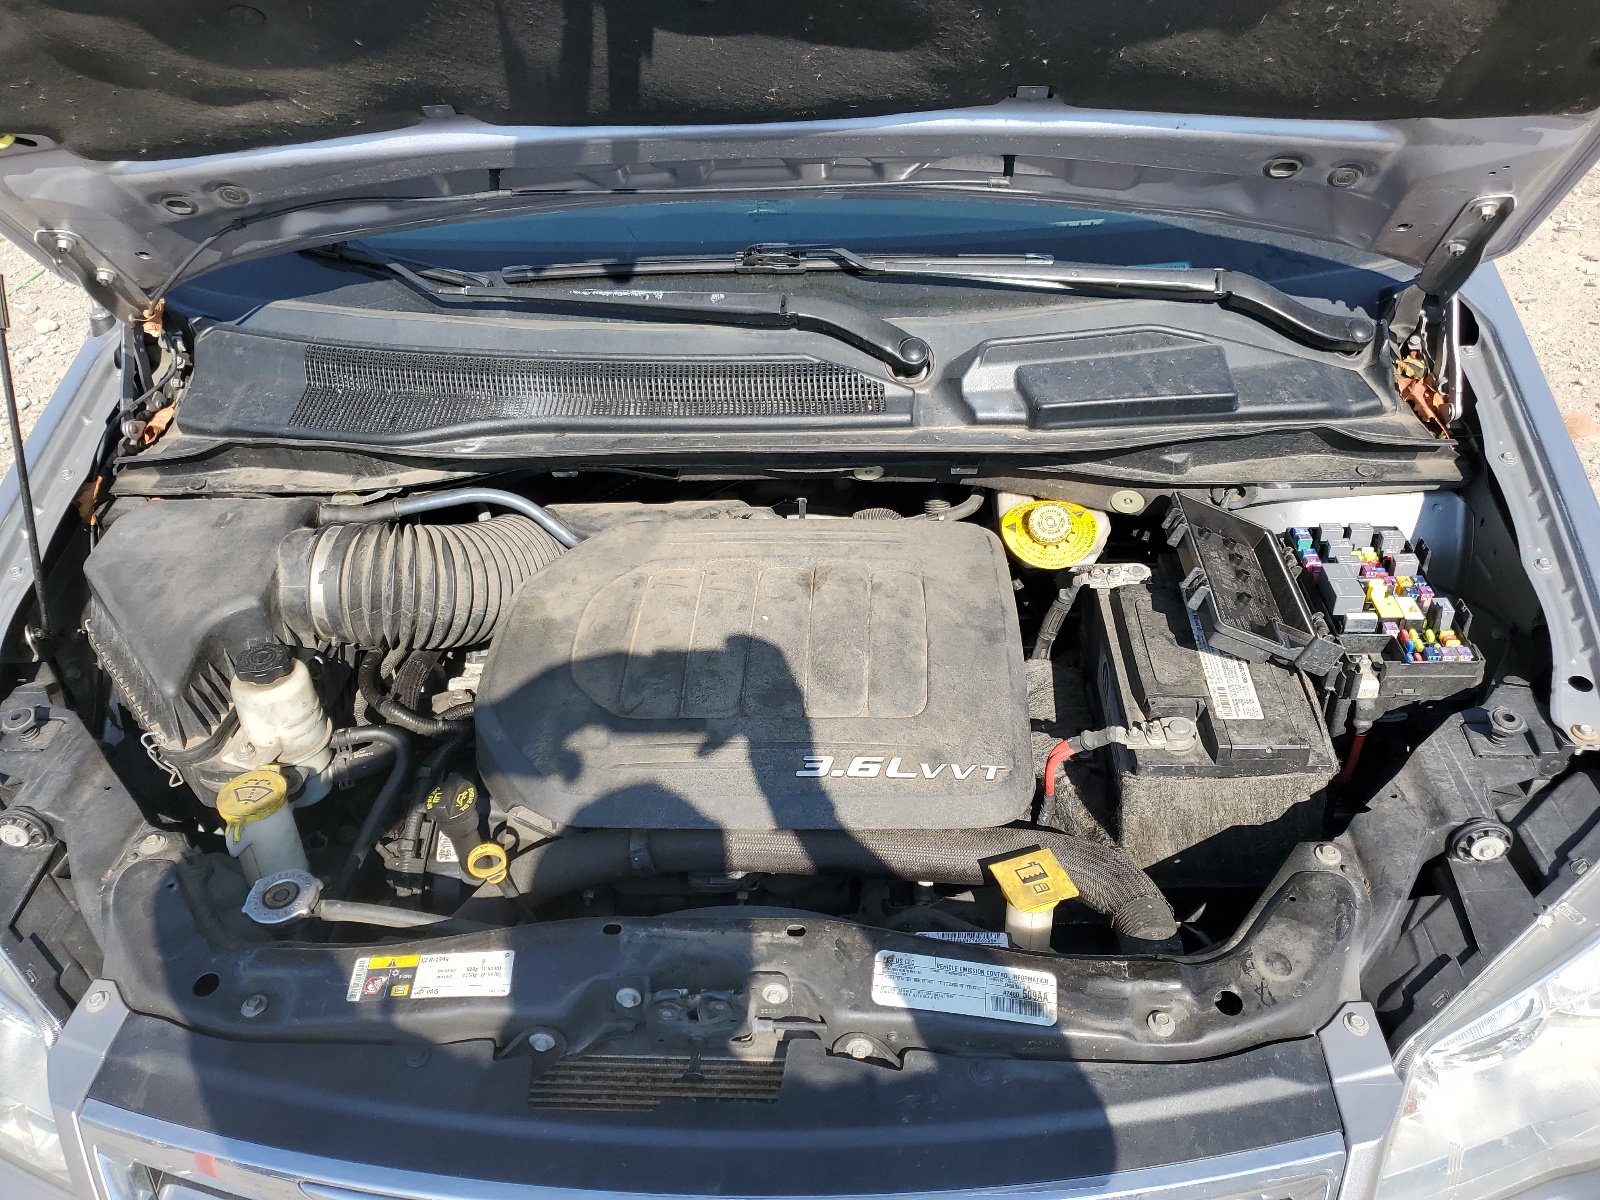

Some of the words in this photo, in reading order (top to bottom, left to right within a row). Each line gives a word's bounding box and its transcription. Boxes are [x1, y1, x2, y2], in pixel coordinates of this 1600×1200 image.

[895, 956, 903, 964] US
[936, 962, 959, 972] VEHICLE
[959, 965, 985, 977] EMISSION
[1011, 973, 1049, 985] NFORMATION
[1022, 988, 1049, 1002] 509AA
